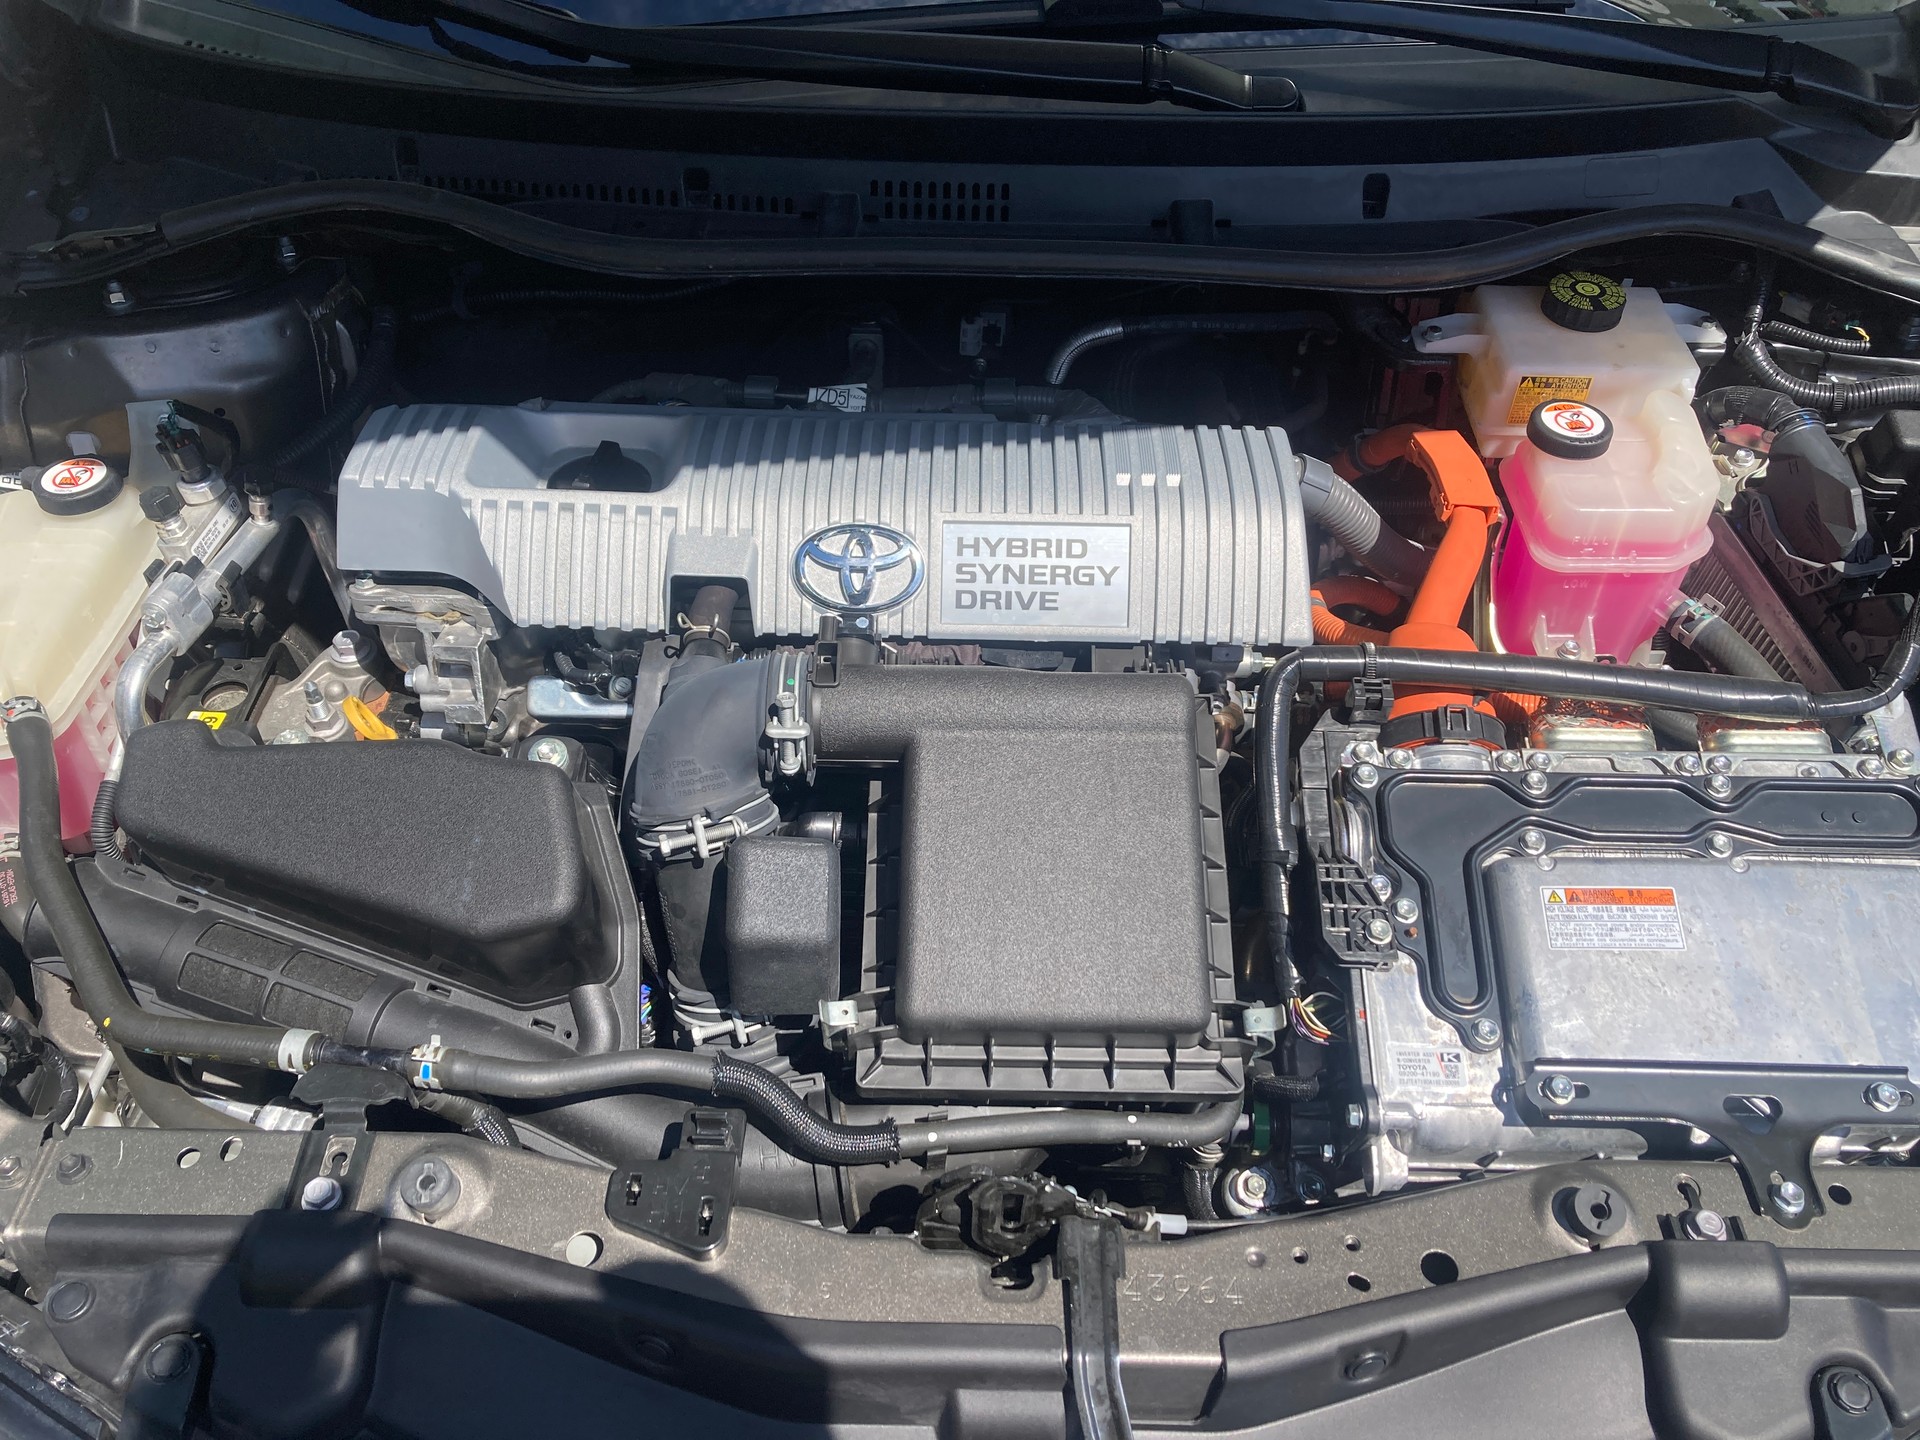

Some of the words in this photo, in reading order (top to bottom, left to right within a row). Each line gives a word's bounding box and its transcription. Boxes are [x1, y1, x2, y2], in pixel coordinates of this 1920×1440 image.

[956, 536, 1088, 559] HYBRID
[1571, 535, 1609, 546] FULL
[955, 563, 1121, 587] SYNERGY
[1562, 578, 1590, 589] LOW
[955, 589, 1060, 611] DRIVE
[1582, 889, 1614, 897] WARNING
[1122, 1270, 1244, 1305] 43964
